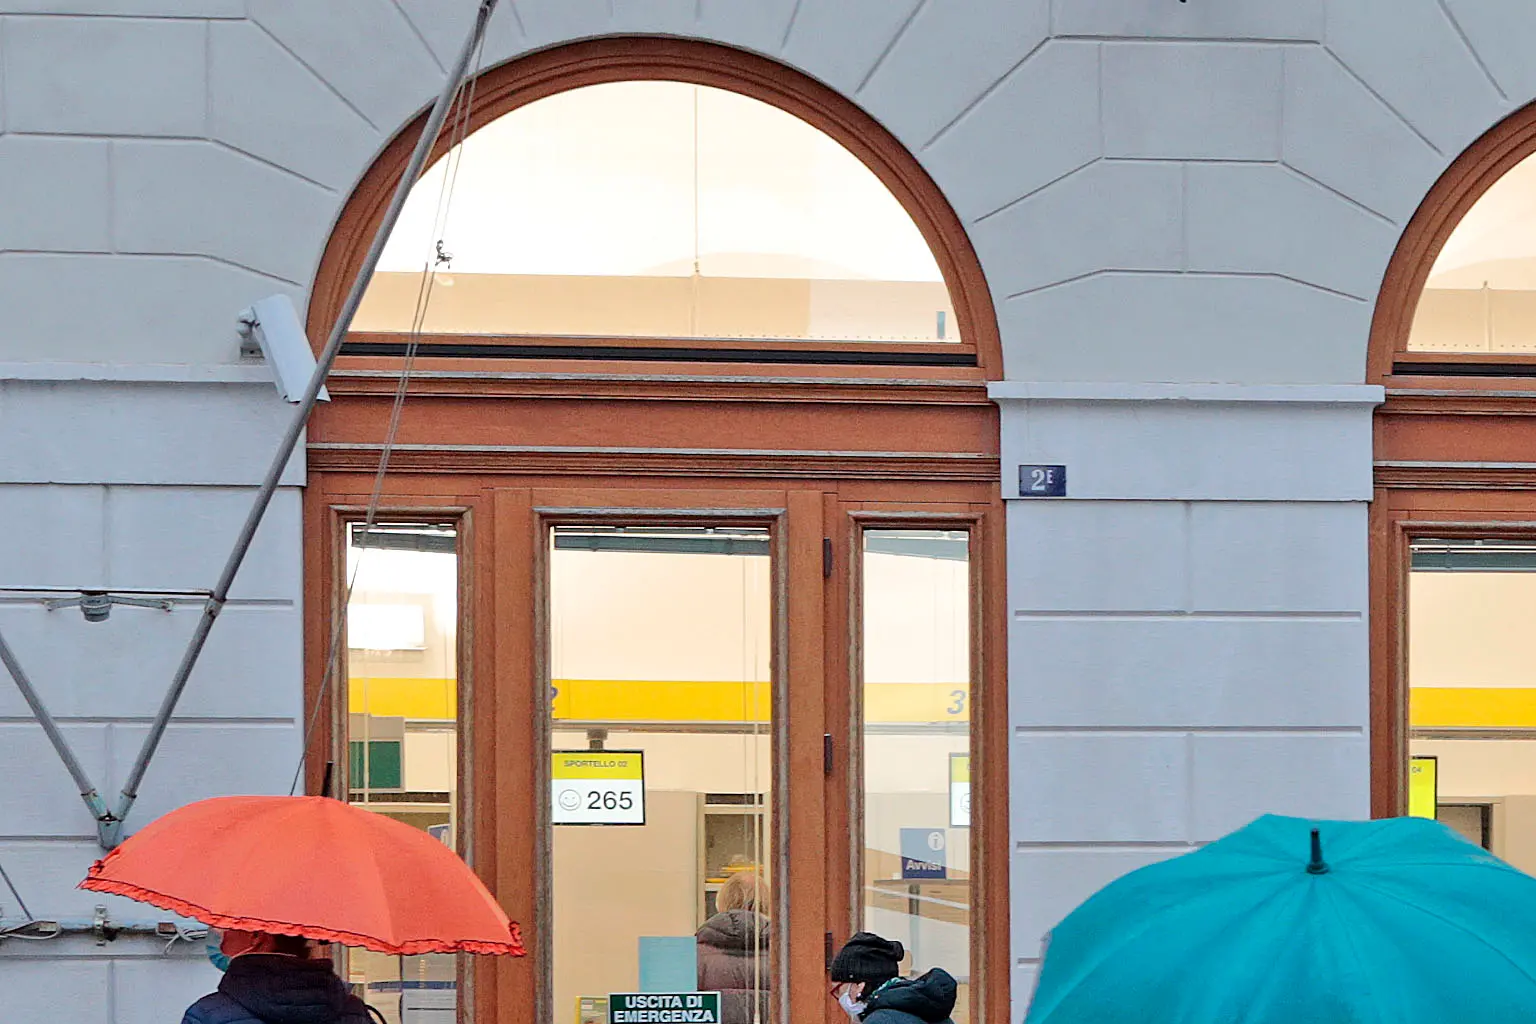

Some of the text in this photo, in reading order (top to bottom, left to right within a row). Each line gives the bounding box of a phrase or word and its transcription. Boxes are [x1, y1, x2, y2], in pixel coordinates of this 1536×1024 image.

[1031, 469, 1054, 491] 2E
[947, 689, 966, 714] 3
[564, 760, 615, 768] SPORTELLO
[587, 791, 633, 810] 265
[906, 859, 942, 871] Avvisi
[625, 995, 703, 1009] USCITA DI
[613, 1009, 715, 1023] EMERGENZA
